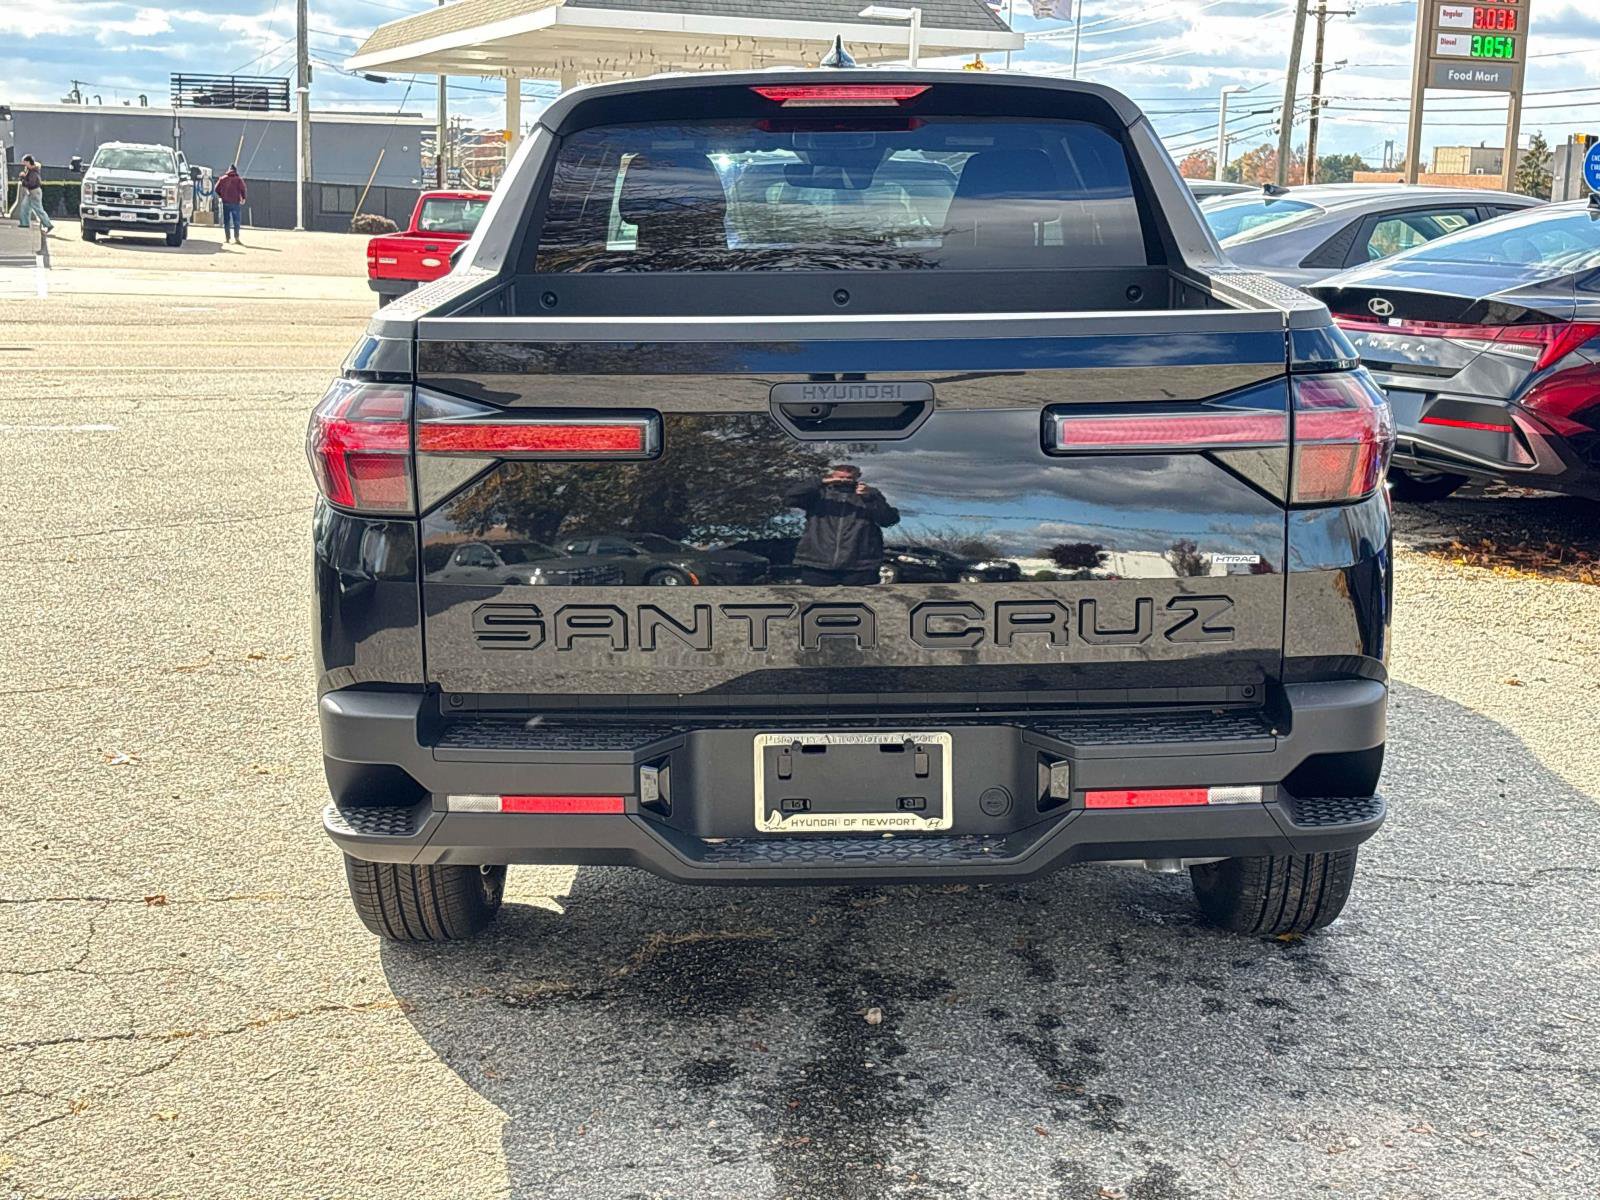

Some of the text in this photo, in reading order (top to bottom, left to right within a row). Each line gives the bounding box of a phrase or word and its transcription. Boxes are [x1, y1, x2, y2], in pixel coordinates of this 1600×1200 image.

[1443, 9, 1463, 19] Regular
[1440, 37, 1457, 46] Diesel
[1448, 69, 1499, 82] Food Mart
[1354, 338, 1426, 352] ANTRA
[802, 384, 901, 400] HYUNDAI
[472, 595, 1235, 651] SANTA CRUZ
[791, 818, 917, 826] HYUNDAI OF NEWPORT
